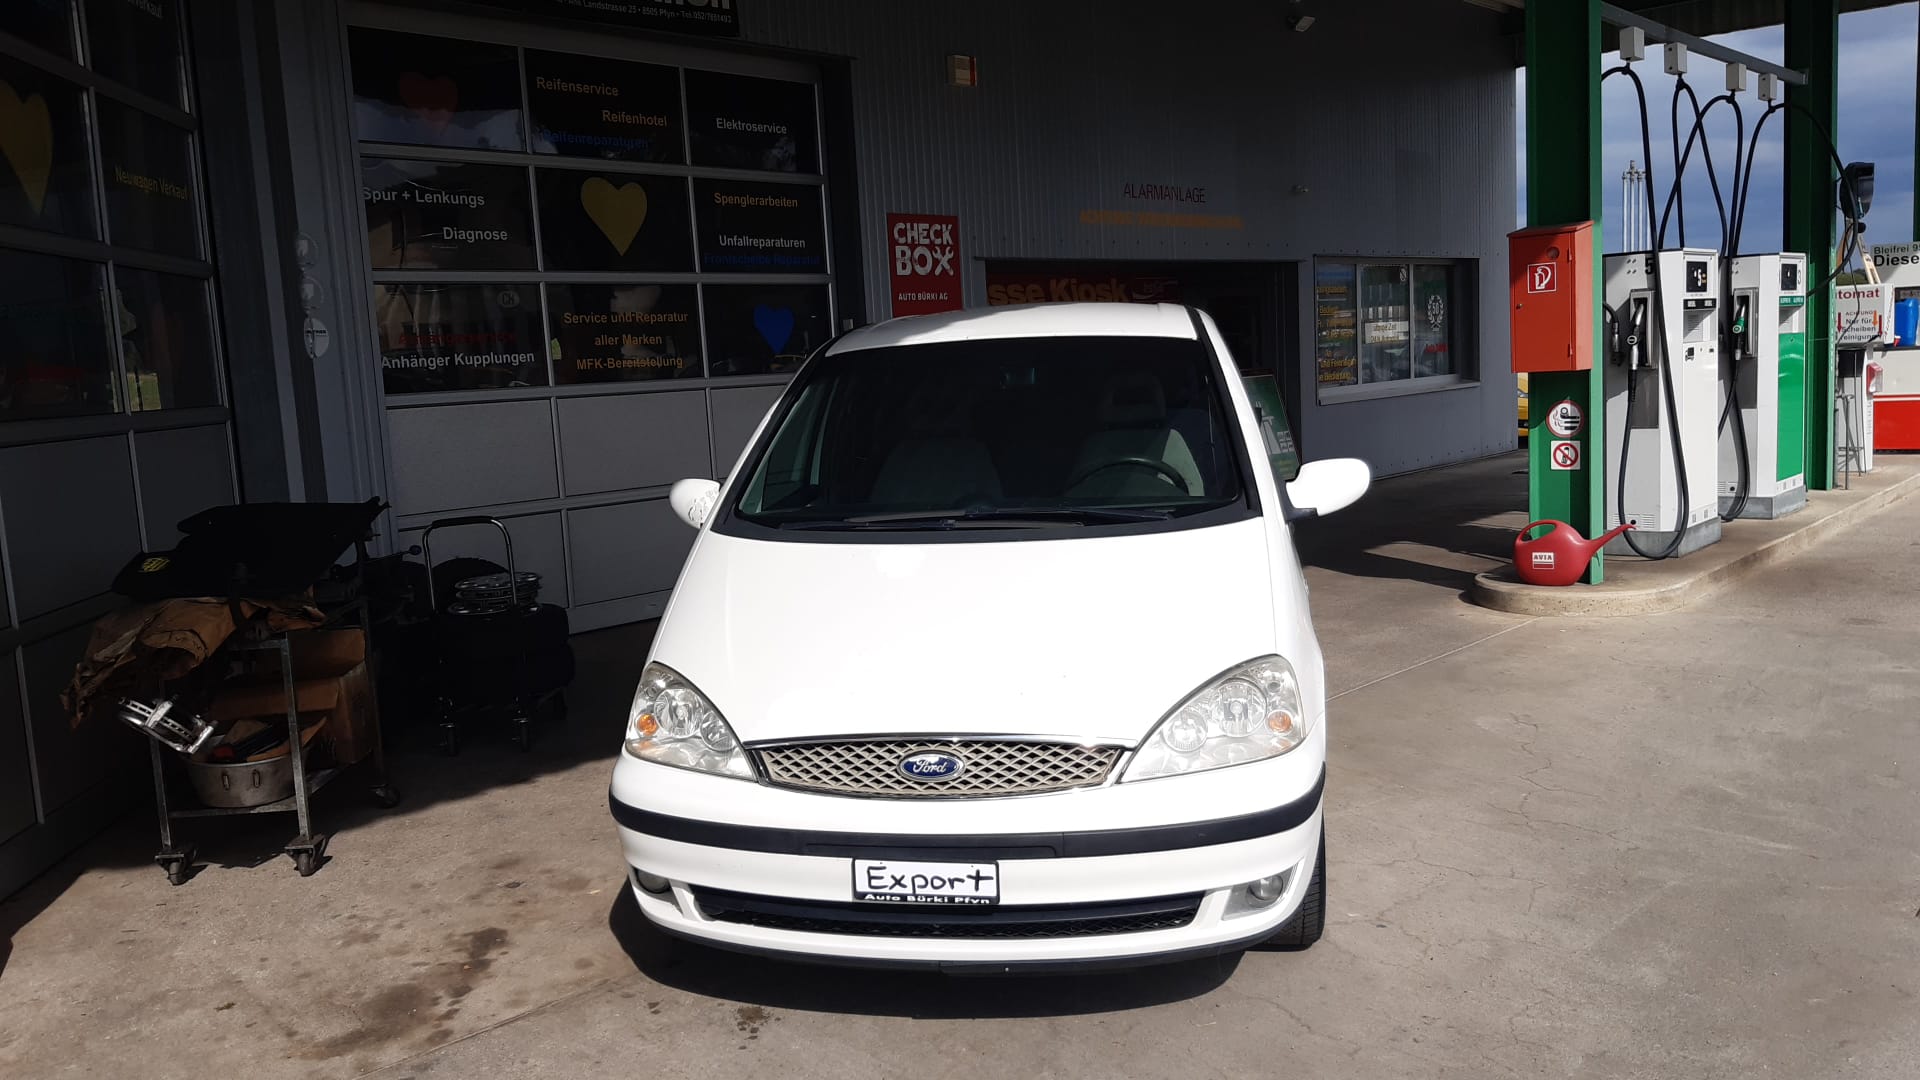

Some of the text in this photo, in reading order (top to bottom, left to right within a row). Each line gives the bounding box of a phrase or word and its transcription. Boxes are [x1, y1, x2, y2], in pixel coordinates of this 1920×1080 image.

[536, 76, 620, 97] Reifenservice
[602, 109, 668, 128] Reifenhotel
[716, 117, 787, 134] Elektroservice
[363, 187, 398, 204] Spur
[415, 190, 486, 208] Lenkungs
[714, 192, 798, 208] Spenglerarbeiten
[1124, 182, 1206, 204] ALARMANLAGE
[443, 226, 508, 244] Diagnose
[719, 234, 806, 250] Unfallreparaturen
[894, 222, 953, 245] CHECK
[1874, 244, 1909, 256] Bleifrei
[895, 245, 954, 276] BOX
[898, 291, 948, 301] AUTO BÜRKI AG
[1049, 276, 1129, 304] Kiosk
[1835, 289, 1881, 300] tomat
[564, 311, 689, 325] Service und Reparatur
[595, 333, 663, 346] aller Marken
[381, 351, 536, 371] Anhänger Kupplungen
[577, 356, 684, 371] MFK-Bereitstellung
[912, 760, 947, 774] Ford
[867, 865, 994, 895] Export
[864, 893, 990, 905] Auto Bürki Pfyn
